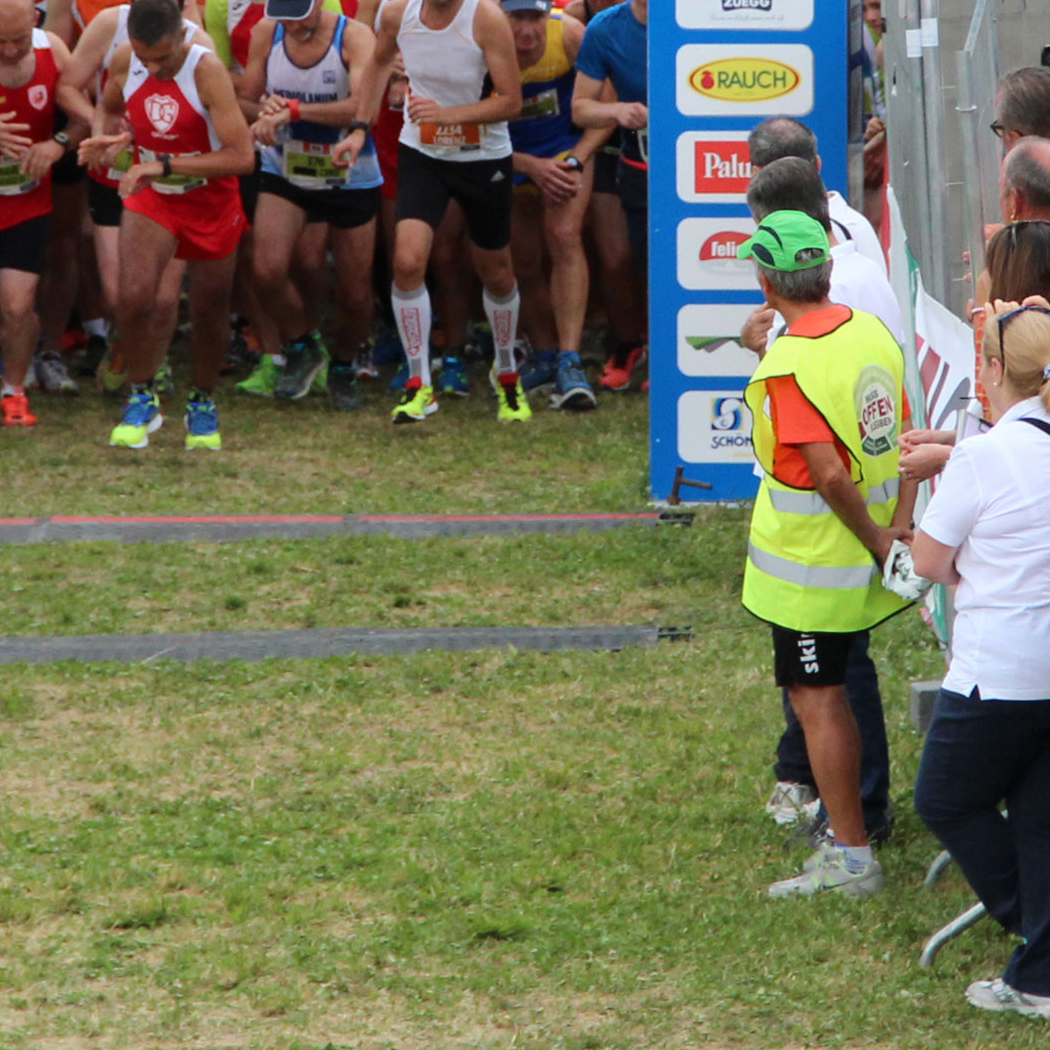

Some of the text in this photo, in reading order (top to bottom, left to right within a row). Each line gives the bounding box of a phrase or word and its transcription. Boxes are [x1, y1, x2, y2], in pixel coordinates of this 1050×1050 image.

[716, 70, 787, 90] RAUCH
[702, 152, 751, 180] Palu
[710, 241, 739, 257] feli
[797, 633, 820, 674] ski
